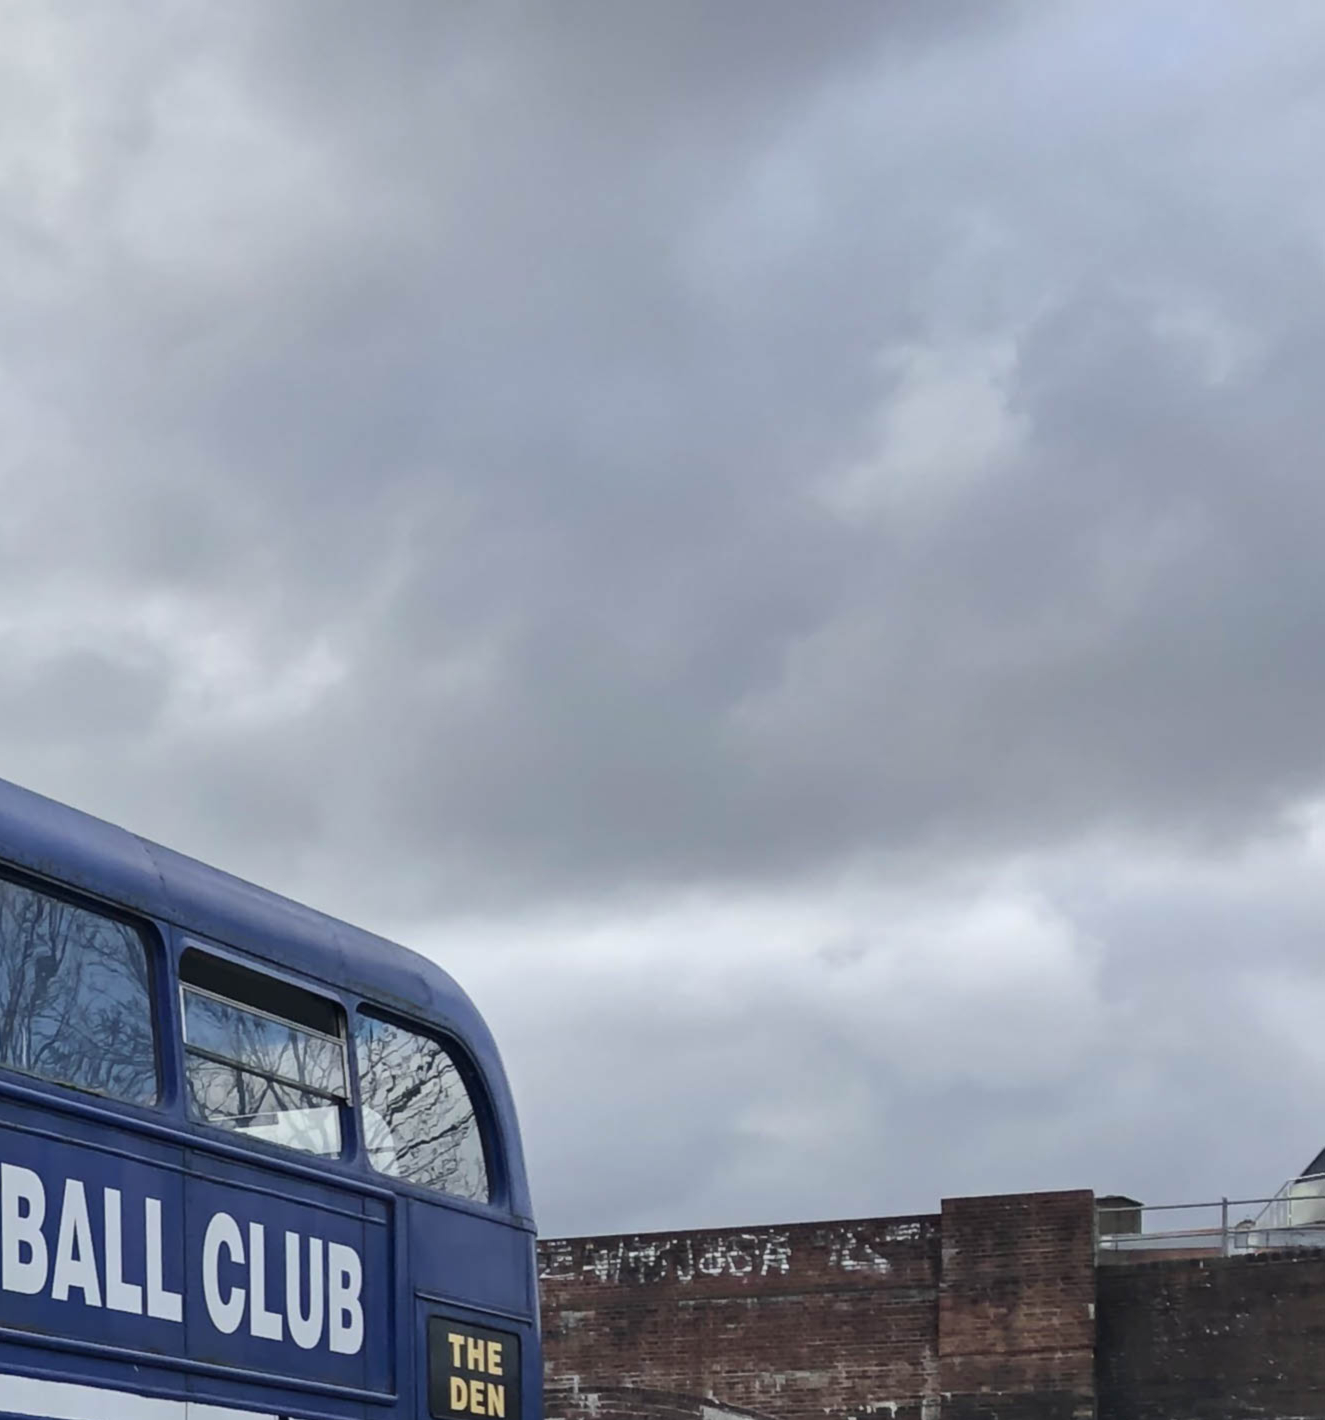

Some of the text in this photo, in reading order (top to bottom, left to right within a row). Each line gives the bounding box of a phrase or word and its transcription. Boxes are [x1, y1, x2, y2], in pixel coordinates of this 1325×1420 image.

[202, 1212, 365, 1354] CLUB
[448, 1333, 503, 1376] THE
[450, 1376, 505, 1418] DEN
